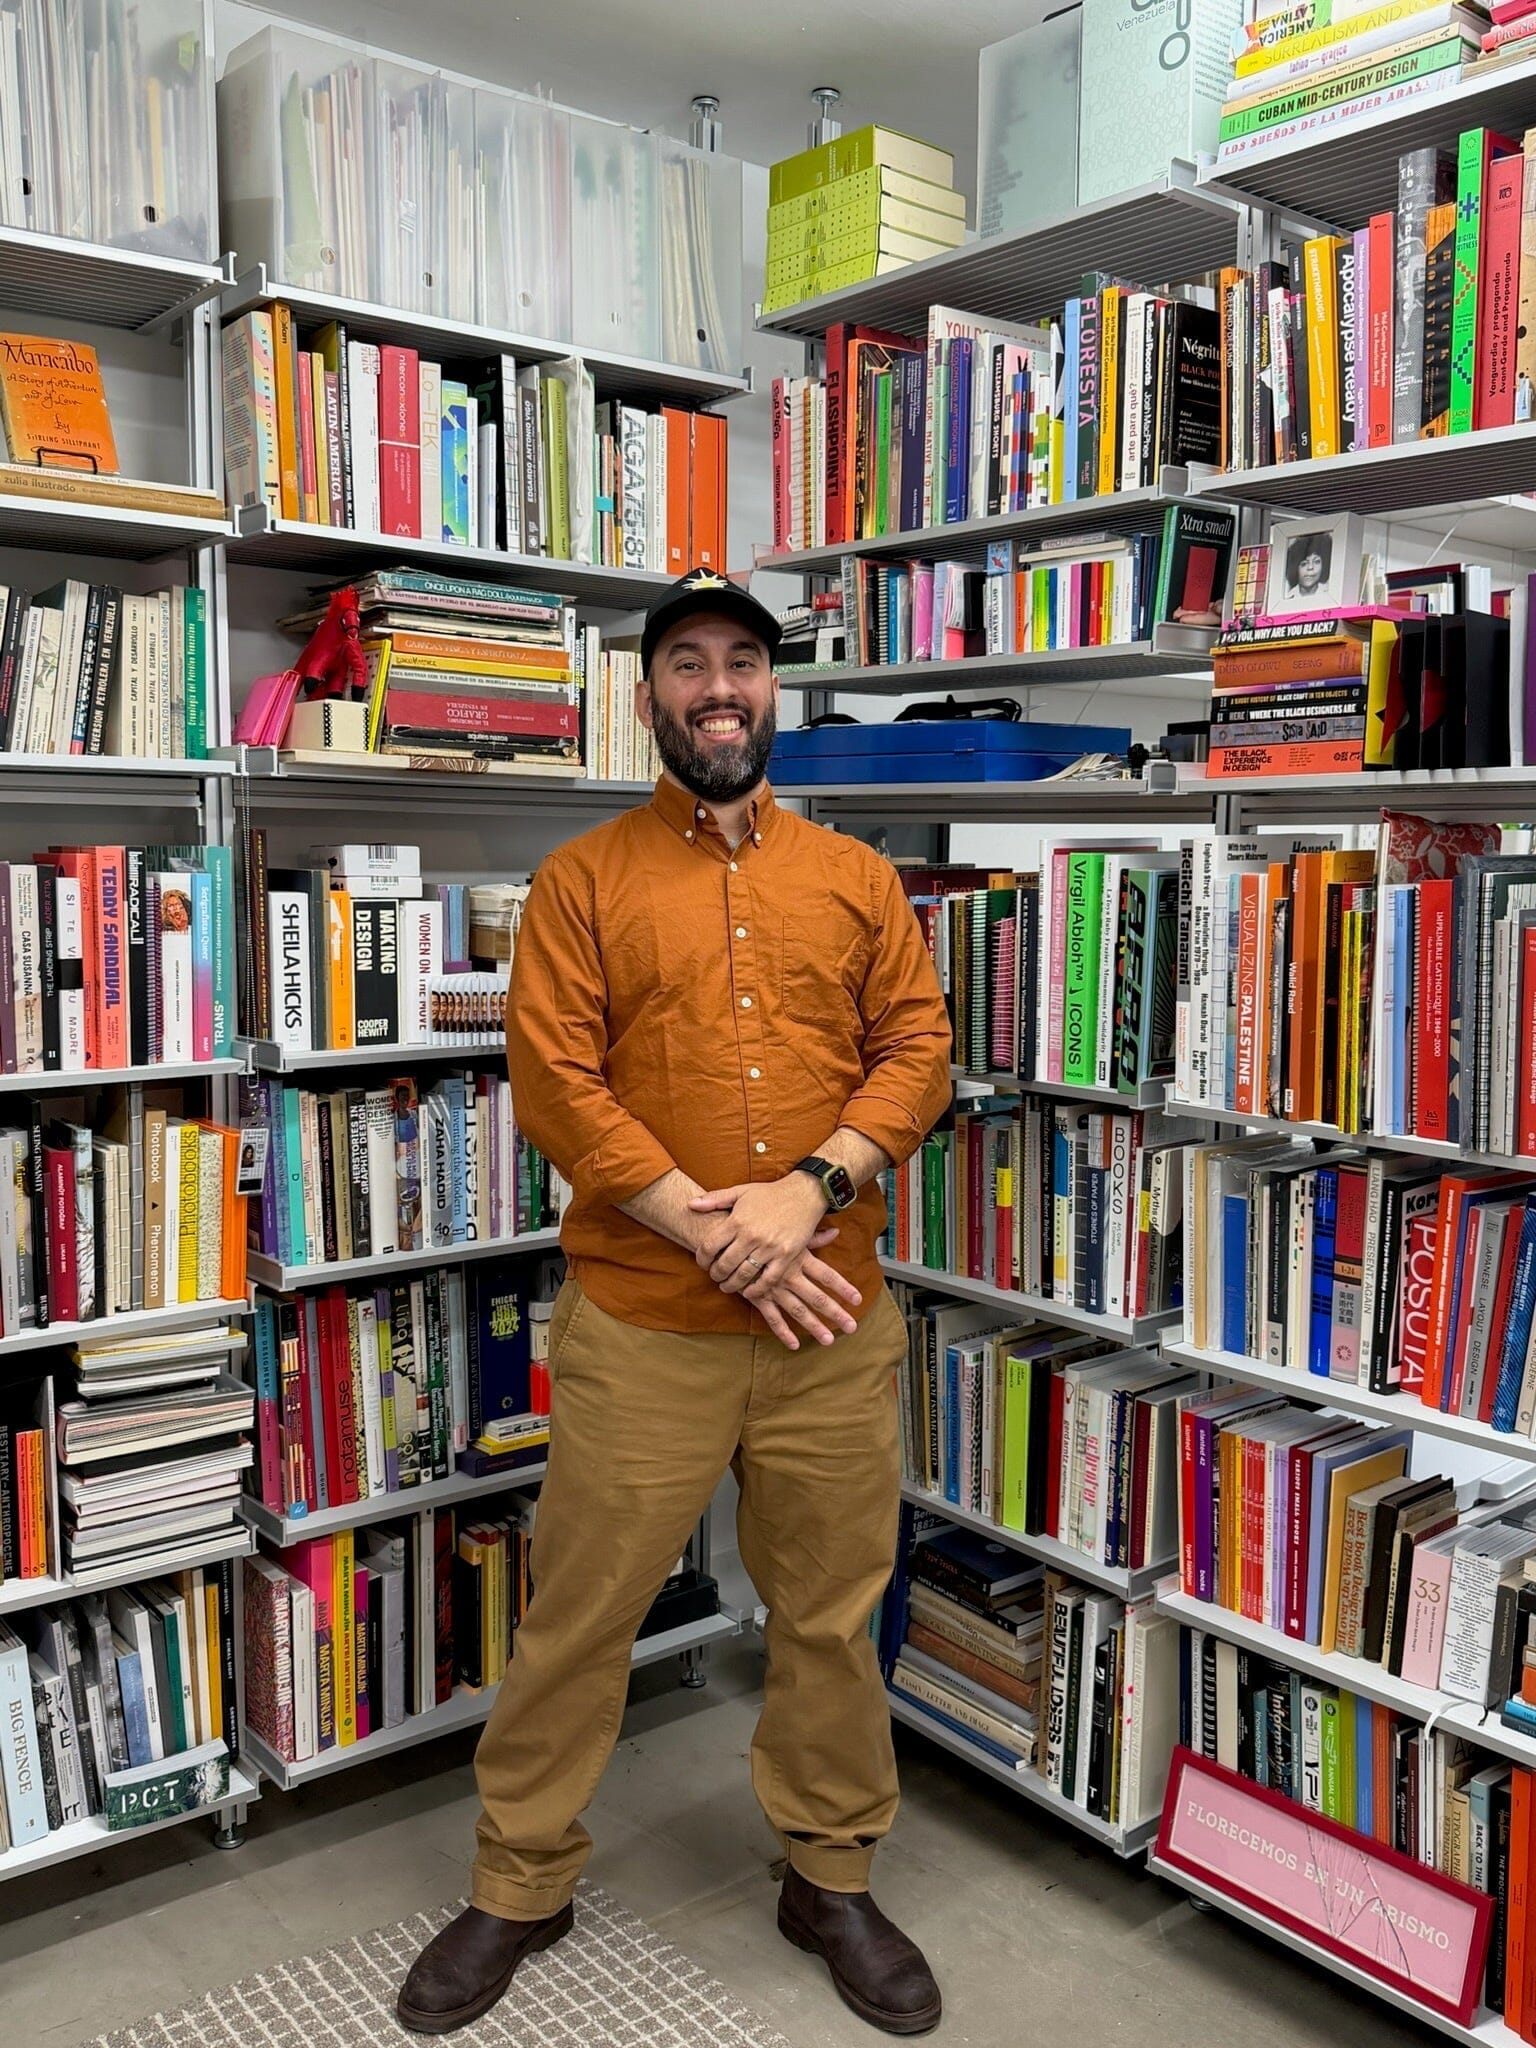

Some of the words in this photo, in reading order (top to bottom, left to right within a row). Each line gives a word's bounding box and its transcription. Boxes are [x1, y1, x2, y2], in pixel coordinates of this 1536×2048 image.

[1116, 2, 1175, 31] Venezuela
[1263, 25, 1362, 65] SURREALISM
[1365, 5, 1403, 30] AND
[1258, 103, 1294, 123] CUBAN
[1297, 74, 1373, 112] MID-CENTURY
[1375, 57, 1419, 88] DESIGN
[1224, 144, 1247, 157] LOS
[1250, 124, 1297, 148] SUEÑOS
[1300, 116, 1317, 131] DE
[1321, 111, 1337, 125] LA
[1340, 96, 1382, 119] MUJER
[1492, 272, 1502, 330] propaganda
[1502, 252, 1512, 311] Propaganda
[1146, 304, 1154, 342] Radical
[1341, 254, 1355, 366] Apocalypse
[0, 340, 94, 374] Maracaibo
[1079, 297, 1096, 428] FLORESTA
[1144, 343, 1153, 386] Records
[1181, 337, 1221, 361] Négritu
[20, 375, 44, 387] Story
[55, 379, 98, 393] Adventure
[993, 352, 1002, 422] WILLIAMSBURG
[1181, 363, 1204, 378] BLACK
[1488, 342, 1498, 397] Vanguardia
[1343, 370, 1355, 423] Ready
[55, 413, 70, 434] By
[827, 371, 840, 498] FLASHPOINT!
[992, 425, 1000, 459] SHORTS
[5, 476, 28, 486] zulia
[32, 478, 76, 492] ilustrado
[1181, 512, 1204, 531] Xtra
[1204, 516, 1232, 536] small
[103, 601, 116, 644] VENEZUELA
[1237, 630, 1254, 642] YOU,
[1254, 628, 1271, 640] WHY
[1271, 626, 1286, 637] ARE
[1287, 623, 1302, 636] YOU
[1303, 621, 1334, 634] BLACK?
[102, 648, 110, 659] EN
[1219, 663, 1245, 673] DURO
[1247, 661, 1281, 672] OLOWU
[96, 663, 110, 706] PETROLERA
[90, 710, 104, 752] REVERSION
[446, 708, 489, 720] GRAFICO
[1229, 711, 1246, 720] HERE
[1250, 709, 1272, 720] WHERE
[1272, 708, 1285, 718] THE
[1286, 707, 1306, 717] BLACK
[1306, 705, 1342, 715] DESIGNERS
[1343, 703, 1357, 713] ARE
[1224, 756, 1272, 764] EXPERIENCE
[1240, 749, 1267, 757] BLACK
[1182, 848, 1193, 901] Keiichi
[1203, 843, 1212, 873] Enghelab
[101, 866, 117, 917] TEDDY
[1069, 859, 1087, 897] Virgil
[1202, 874, 1210, 900] Street,
[200, 887, 208, 937] Serigrafistas
[21, 931, 31, 953] CASA
[282, 903, 300, 970] SHEILA
[355, 909, 372, 971] DESIGN
[378, 909, 396, 975] MAKING
[419, 912, 431, 956] WOMEN
[1179, 907, 1192, 986] Tanaami
[1436, 912, 1444, 960] IMPRIMERIE
[22, 956, 33, 996] SUSANNA
[419, 959, 431, 975] ON
[1288, 962, 1297, 989] Walid
[283, 974, 302, 1029] HICKS
[1287, 990, 1296, 1014] Raad
[1432, 962, 1443, 1014] CATHOLIQUE
[357, 1018, 389, 1029] COOPER
[358, 1028, 388, 1037] HEWITT
[1068, 1002, 1083, 1065] ICONS
[350, 1105, 359, 1118] IN
[357, 1104, 367, 1146] DESIGN
[452, 1106, 461, 1155] Inventing
[33, 1124, 42, 1154] SEEING
[152, 1122, 162, 1184] Photobook
[351, 1121, 361, 1184] HERSTORIES
[435, 1118, 445, 1160] ZAHA
[34, 1156, 44, 1192] INSANITY
[180, 1130, 197, 1238] Photobooks
[359, 1148, 369, 1195] GRAPHIC
[436, 1163, 446, 1209] HADID
[1112, 1127, 1126, 1215] BOOKS
[1370, 1168, 1380, 1198] LIANG
[454, 1176, 463, 1216] Modern
[1091, 1200, 1098, 1210] OF
[1368, 1200, 1378, 1222] HAO
[1090, 1212, 1098, 1244] STORIES
[152, 1224, 162, 1297] Phenomenon
[1481, 1242, 1493, 1290] JAPANESE
[491, 1294, 517, 1304] EMIGRE
[1364, 1282, 1374, 1314] AGAIN
[1476, 1298, 1486, 1334] LAYOUT
[491, 1320, 520, 1335] 2024
[1471, 1340, 1482, 1376] DESIGN
[338, 1380, 352, 1484] notamuse
[1356, 1511, 1368, 1538] Best
[1354, 1541, 1366, 1572] Book
[1351, 1575, 1363, 1614] Design
[1414, 1577, 1441, 1603] 33
[1051, 1601, 1068, 1690] BEAUTIFUL
[1348, 1619, 1360, 1650] from
[319, 1644, 331, 1686] MARTA
[9, 1699, 23, 1735] BIG
[926, 1691, 953, 1712] LETTER
[1047, 1690, 1064, 1746] LOSERS
[1272, 1693, 1284, 1785] Information
[13, 1735, 33, 1795] FENCE
[1186, 1802, 1298, 1872] FLORECEMOS
[1303, 1862, 1329, 1888] EN
[1335, 1876, 1366, 1906] UN
[1475, 1853, 1483, 1868] TO
[1475, 1869, 1483, 1886] THE
